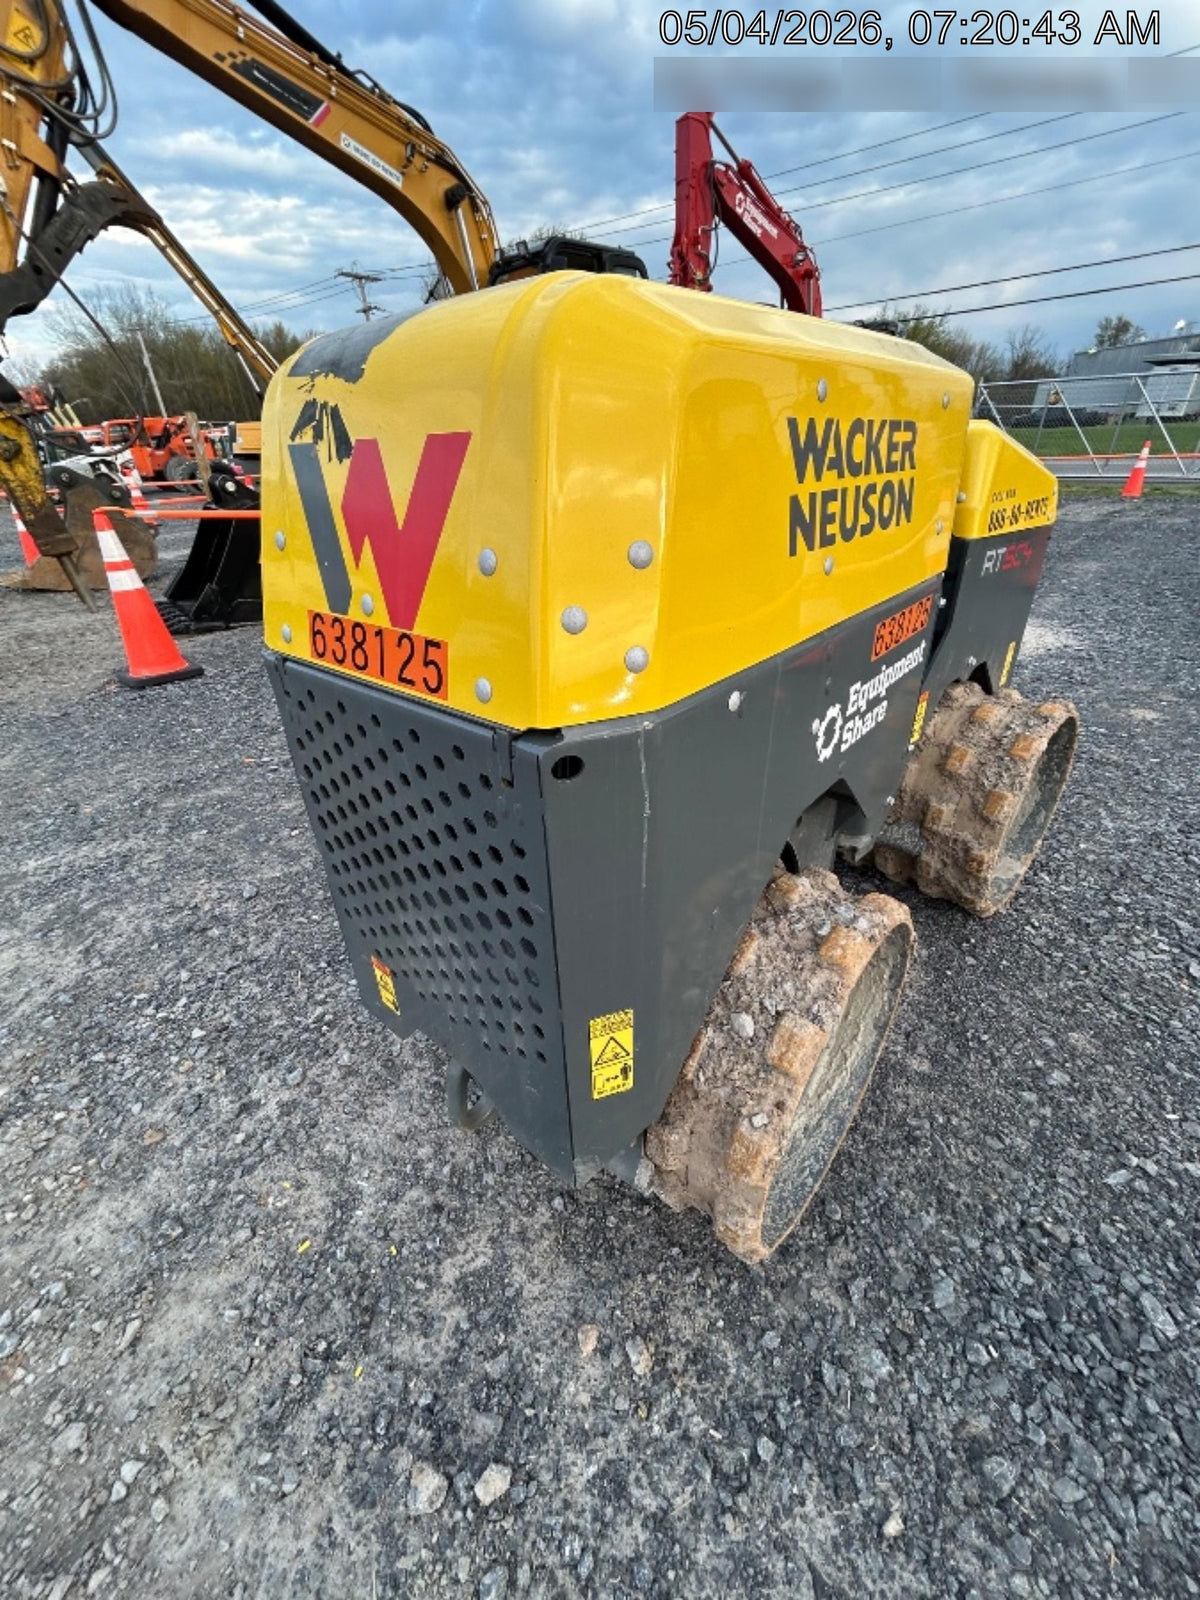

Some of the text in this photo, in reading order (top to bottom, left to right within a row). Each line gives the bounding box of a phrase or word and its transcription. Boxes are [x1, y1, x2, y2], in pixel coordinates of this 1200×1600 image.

[787, 417, 918, 484] WACKER
[789, 476, 915, 557] NEUSON
[311, 612, 443, 694] 638125
[874, 596, 931, 658] 638125
[846, 639, 927, 717] Equipment
[840, 700, 888, 753] Share
